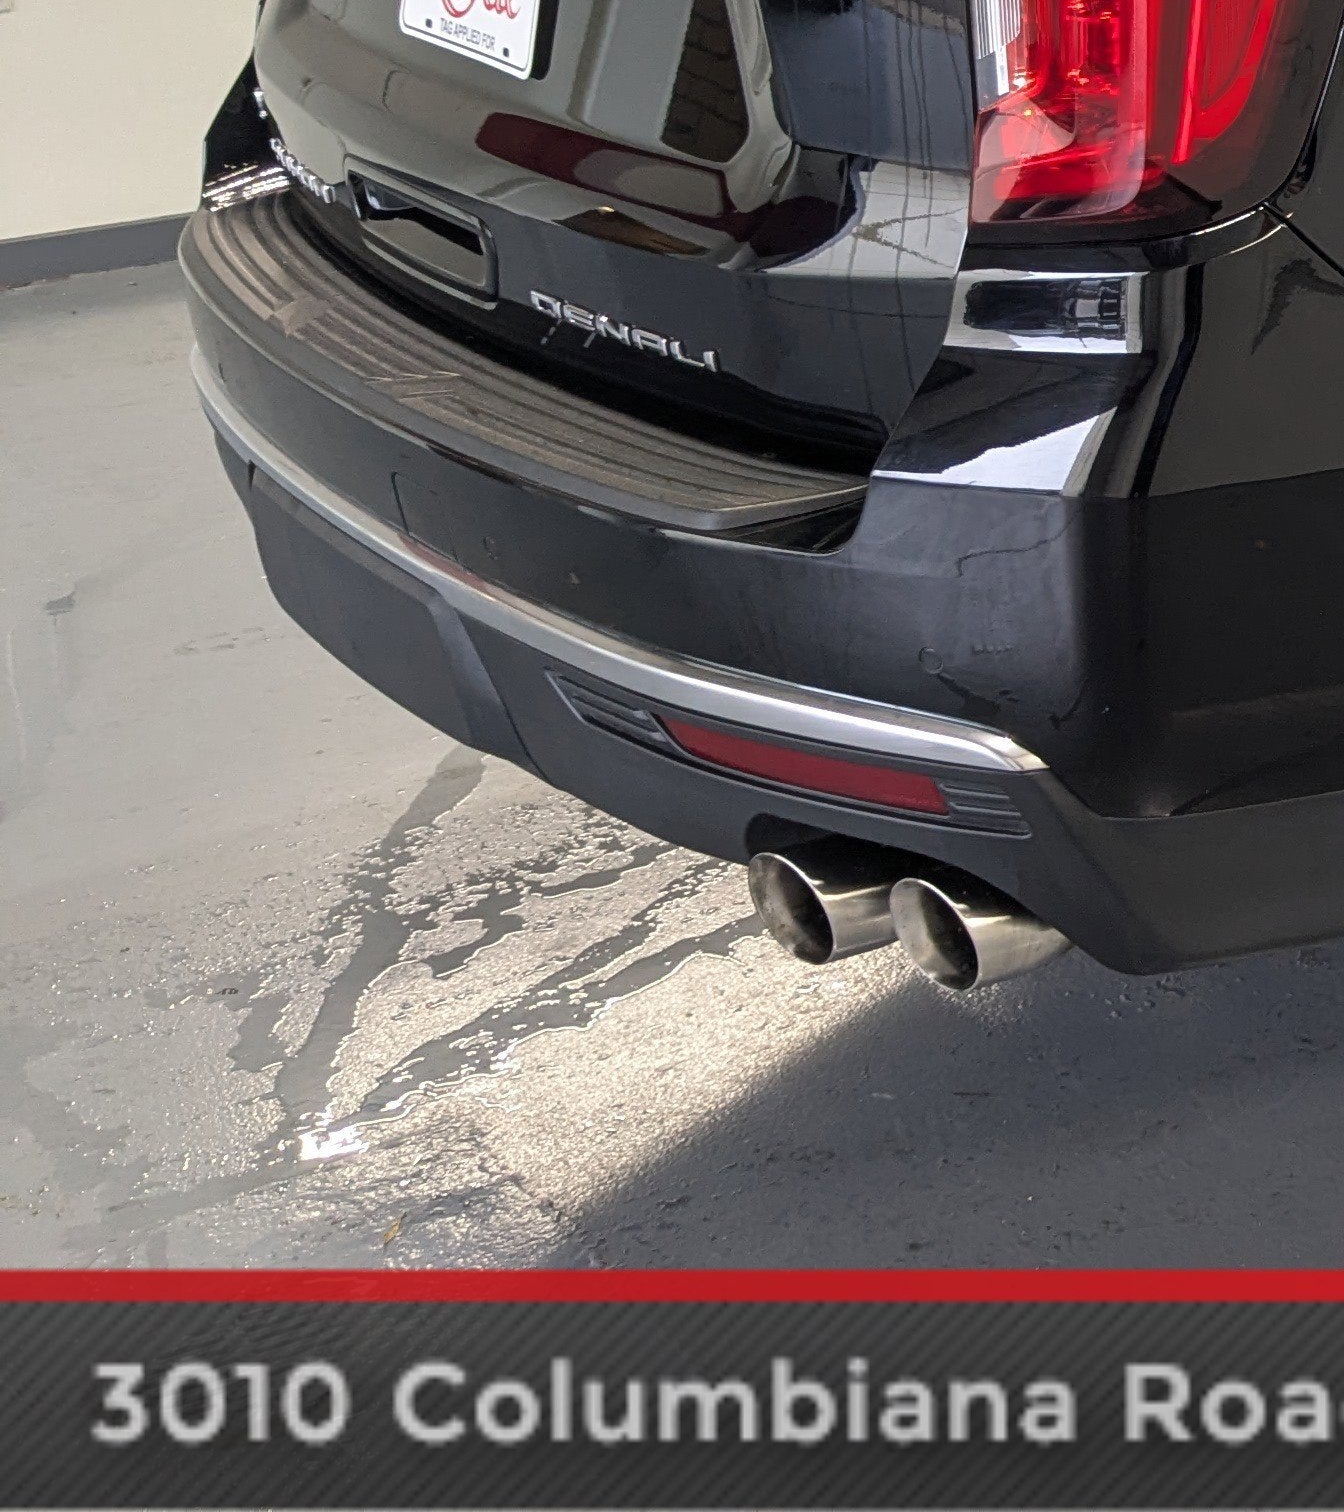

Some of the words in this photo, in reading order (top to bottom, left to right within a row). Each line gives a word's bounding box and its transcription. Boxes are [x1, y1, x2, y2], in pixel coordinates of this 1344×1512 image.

[440, 17, 453, 35] TAG
[481, 32, 496, 51] FOR
[530, 290, 717, 373] DENALI
